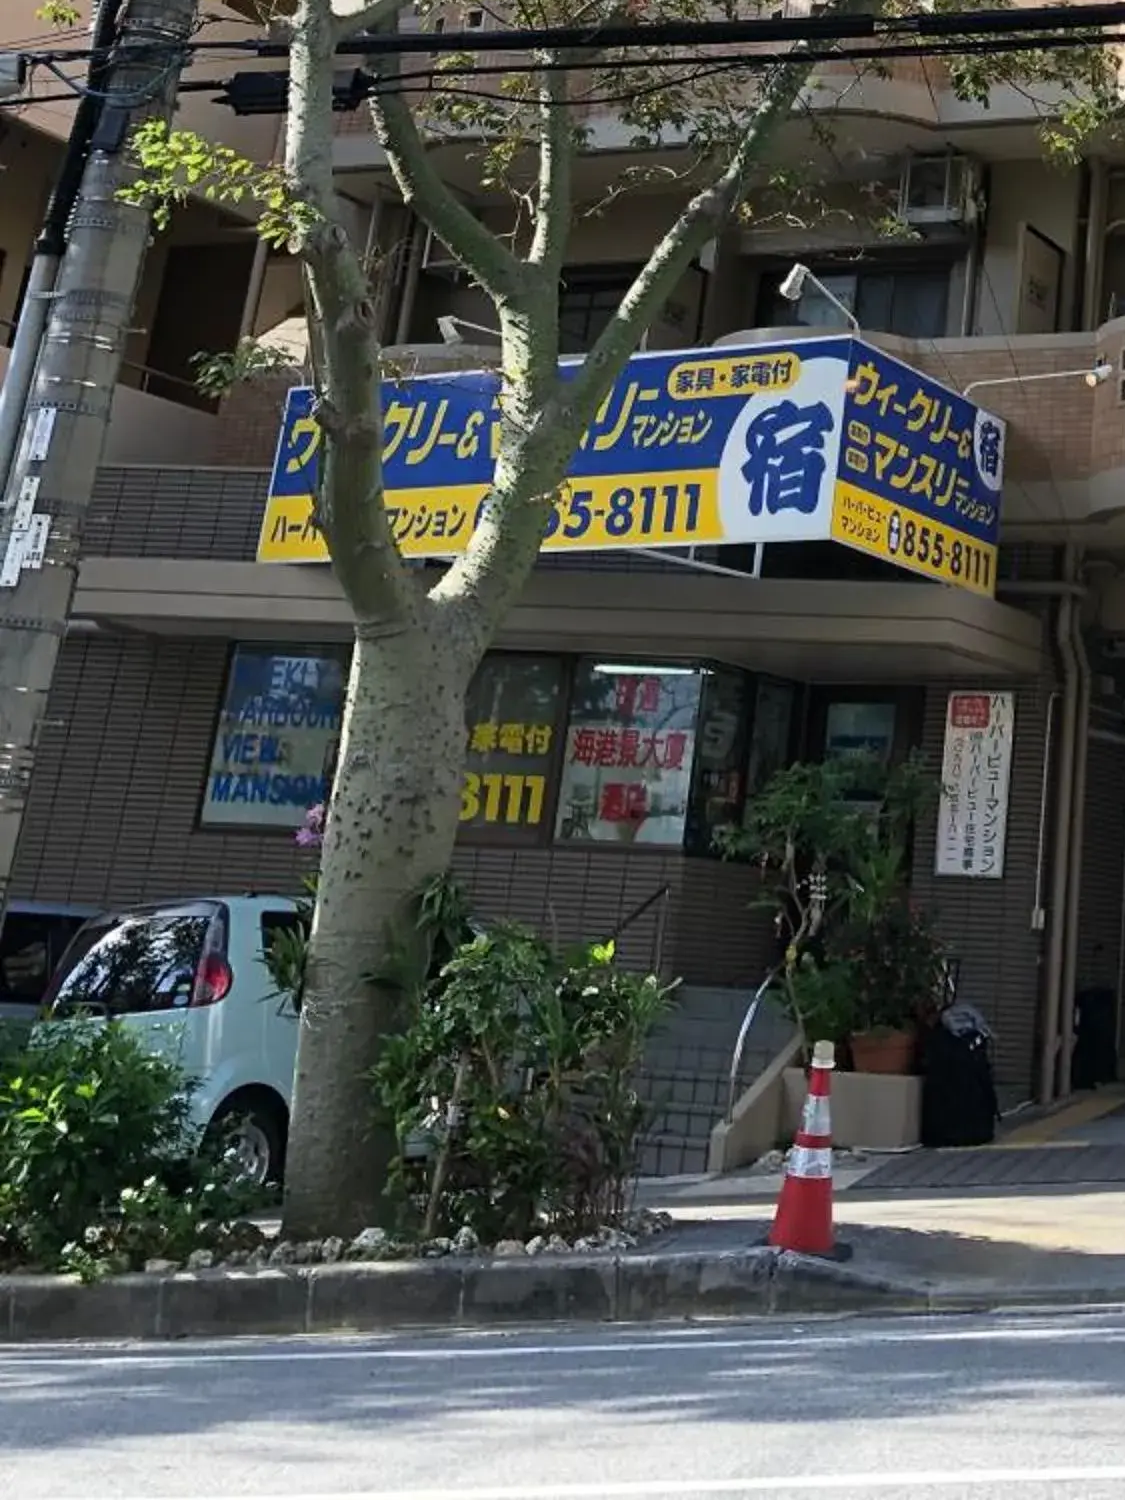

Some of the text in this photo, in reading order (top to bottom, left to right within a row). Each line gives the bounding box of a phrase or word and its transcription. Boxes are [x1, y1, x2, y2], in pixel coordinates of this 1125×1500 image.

[674, 362, 792, 391] 家具・家電付
[632, 410, 713, 448] マンション
[741, 400, 834, 516] 宿
[874, 432, 970, 507] マンスリー
[841, 515, 881, 543] マンション
[903, 520, 990, 588] 855-8111
